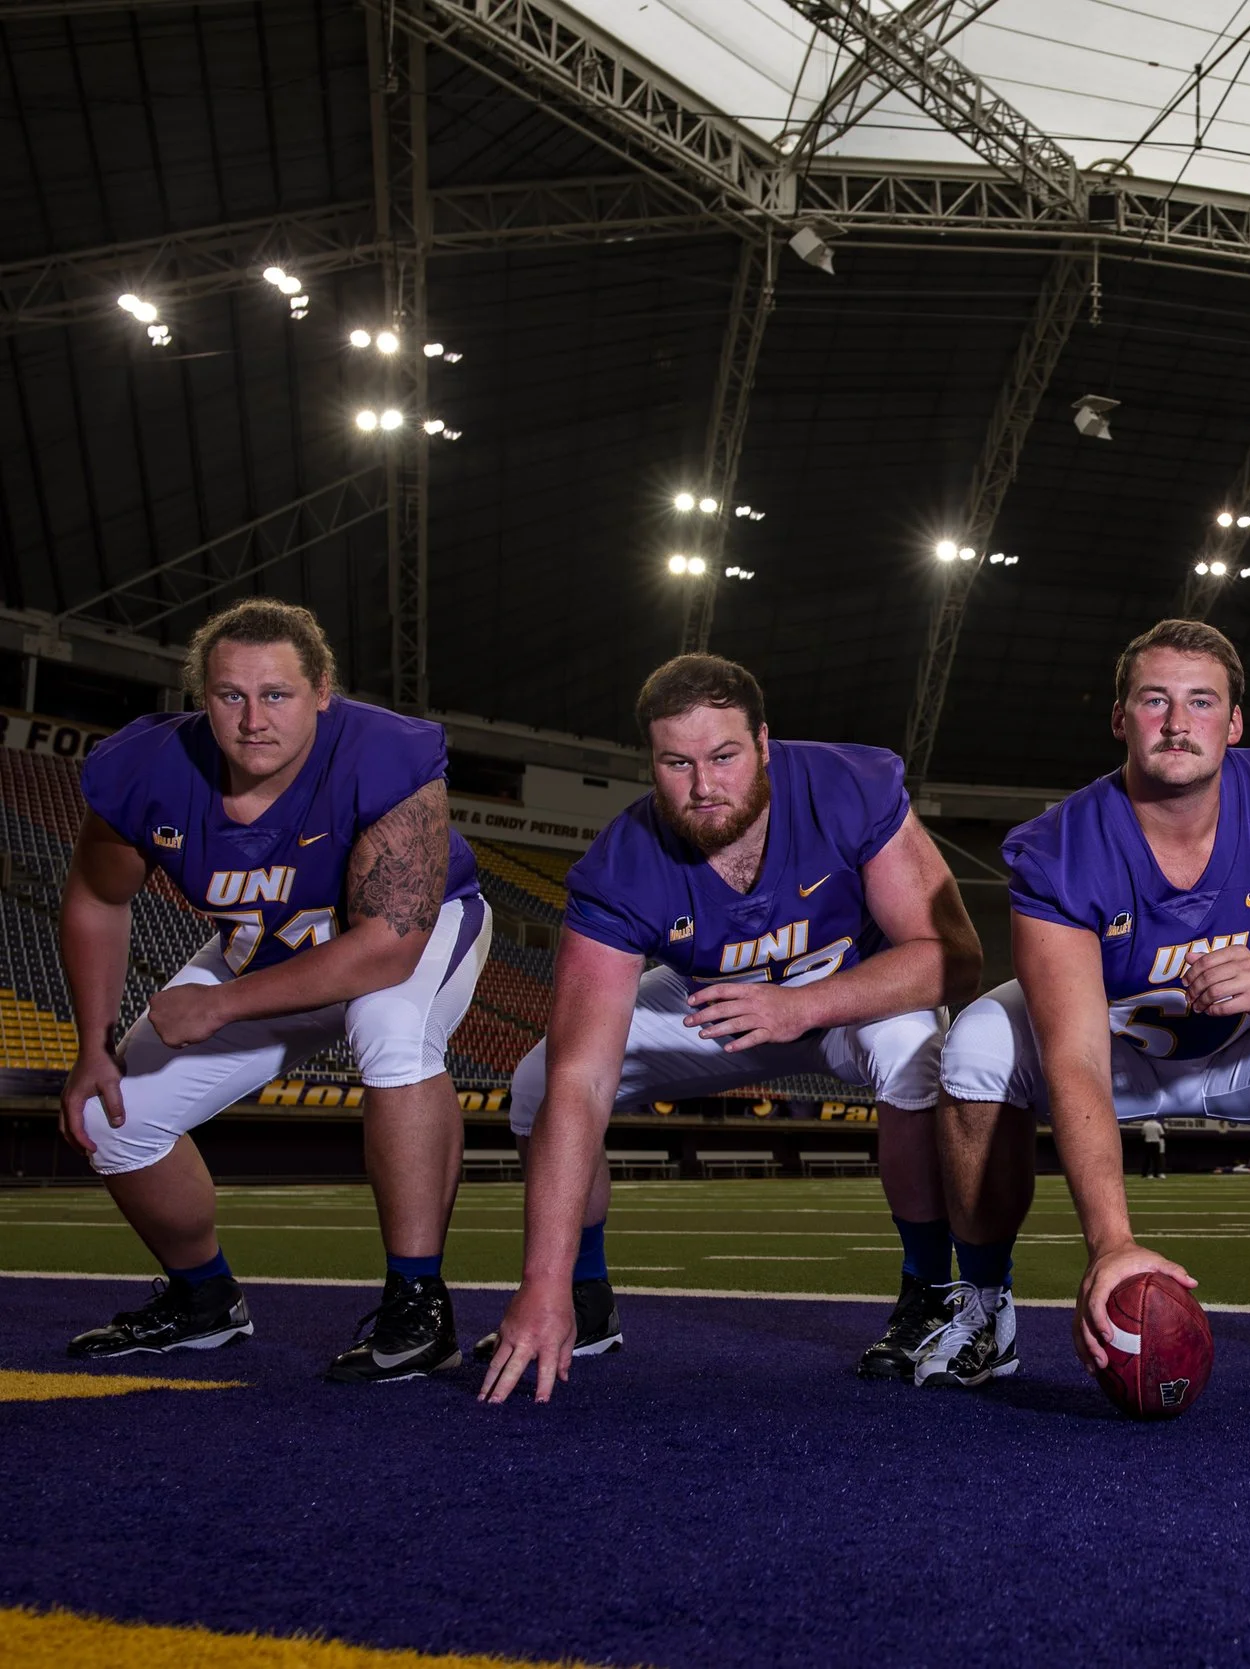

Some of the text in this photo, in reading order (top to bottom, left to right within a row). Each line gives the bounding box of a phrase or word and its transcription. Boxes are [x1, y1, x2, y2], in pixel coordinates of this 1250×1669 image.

[471, 813, 481, 824] &
[486, 814, 527, 831] CINDY
[531, 821, 578, 838] PETERS
[205, 865, 297, 906] UNI
[720, 919, 809, 973] UNI
